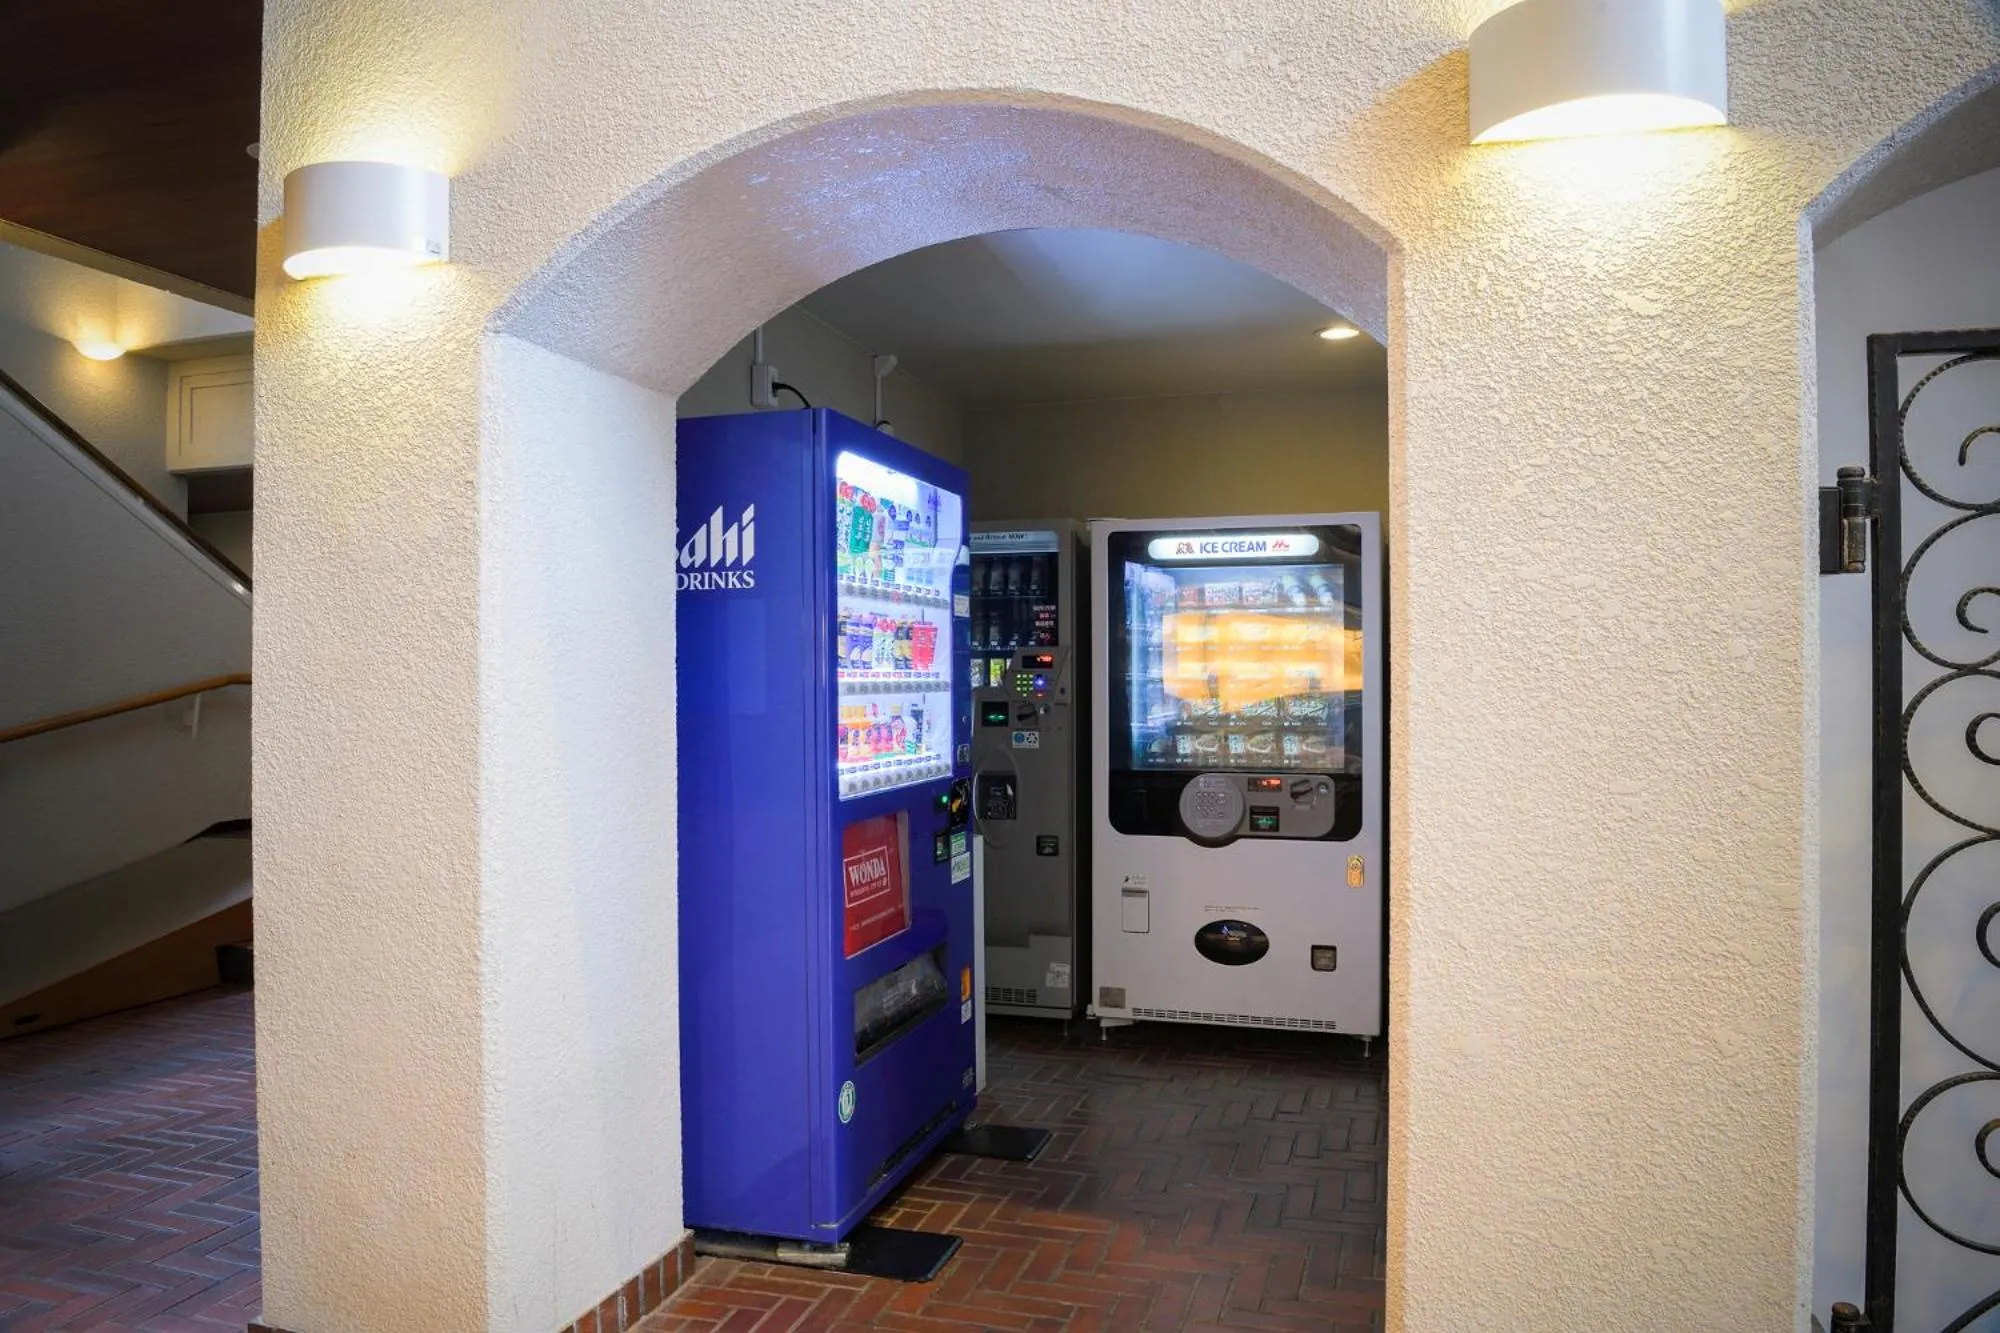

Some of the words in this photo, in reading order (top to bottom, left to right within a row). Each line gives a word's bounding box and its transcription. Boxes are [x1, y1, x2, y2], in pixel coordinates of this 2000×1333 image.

[678, 503, 755, 568] ahi
[1200, 542, 1219, 554] ICE
[1221, 540, 1267, 553] CREAM
[677, 570, 755, 591] DRINKS
[848, 855, 887, 889] WONDA
